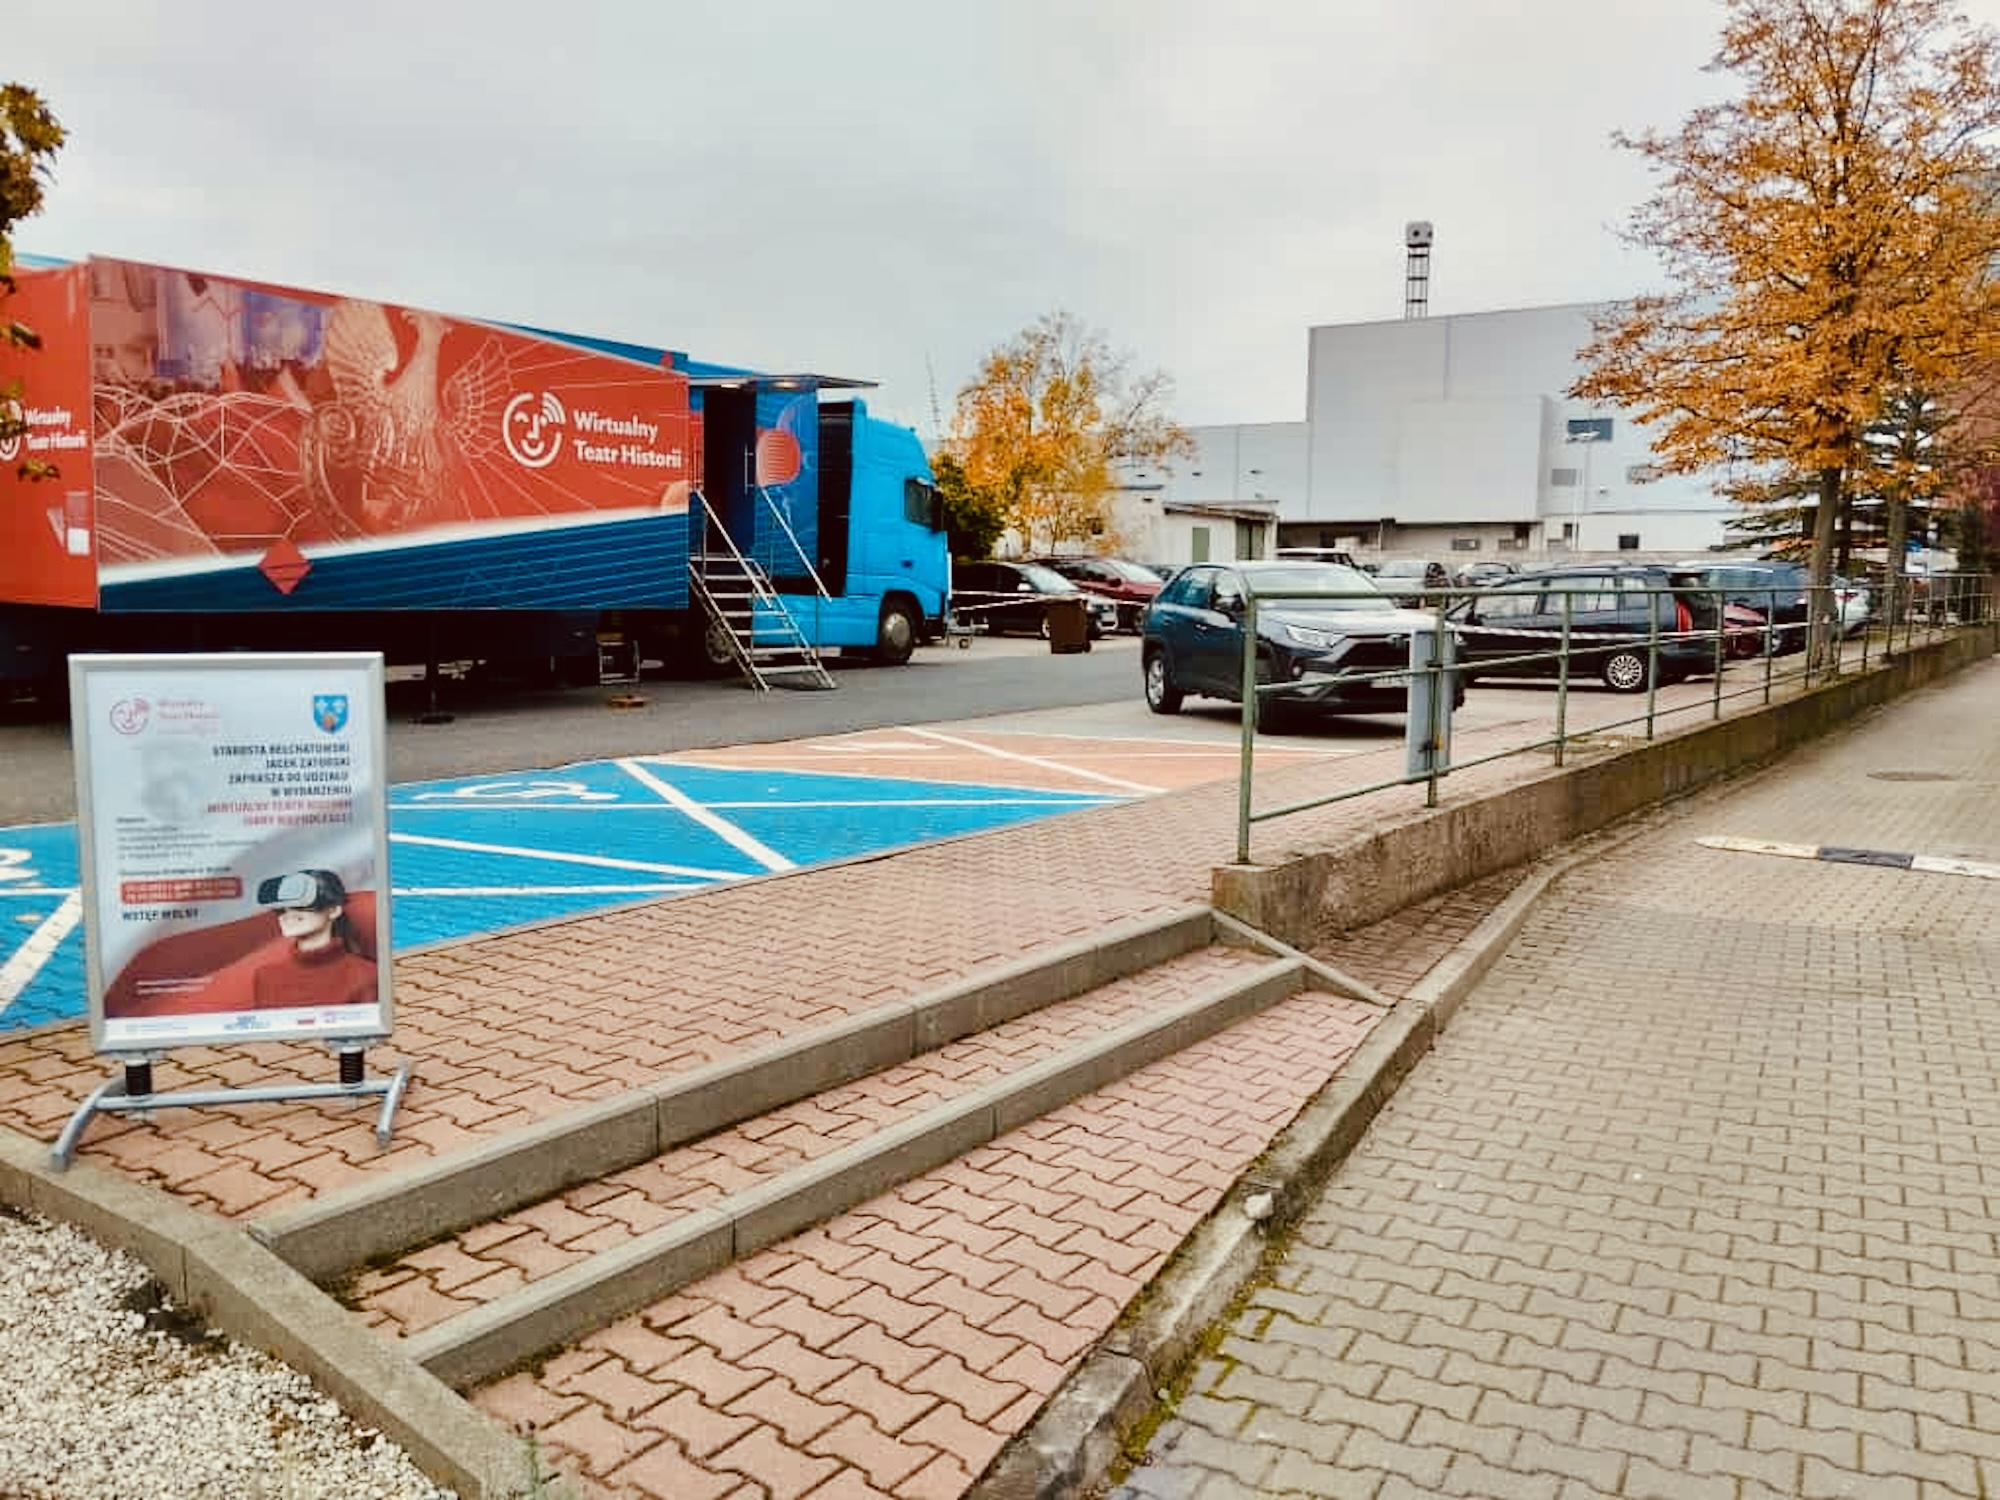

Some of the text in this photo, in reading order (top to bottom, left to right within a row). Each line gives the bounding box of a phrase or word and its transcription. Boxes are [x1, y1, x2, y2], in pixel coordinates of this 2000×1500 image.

[573, 409, 658, 444] Wirtualny
[573, 439, 683, 469] Teatr Historii
